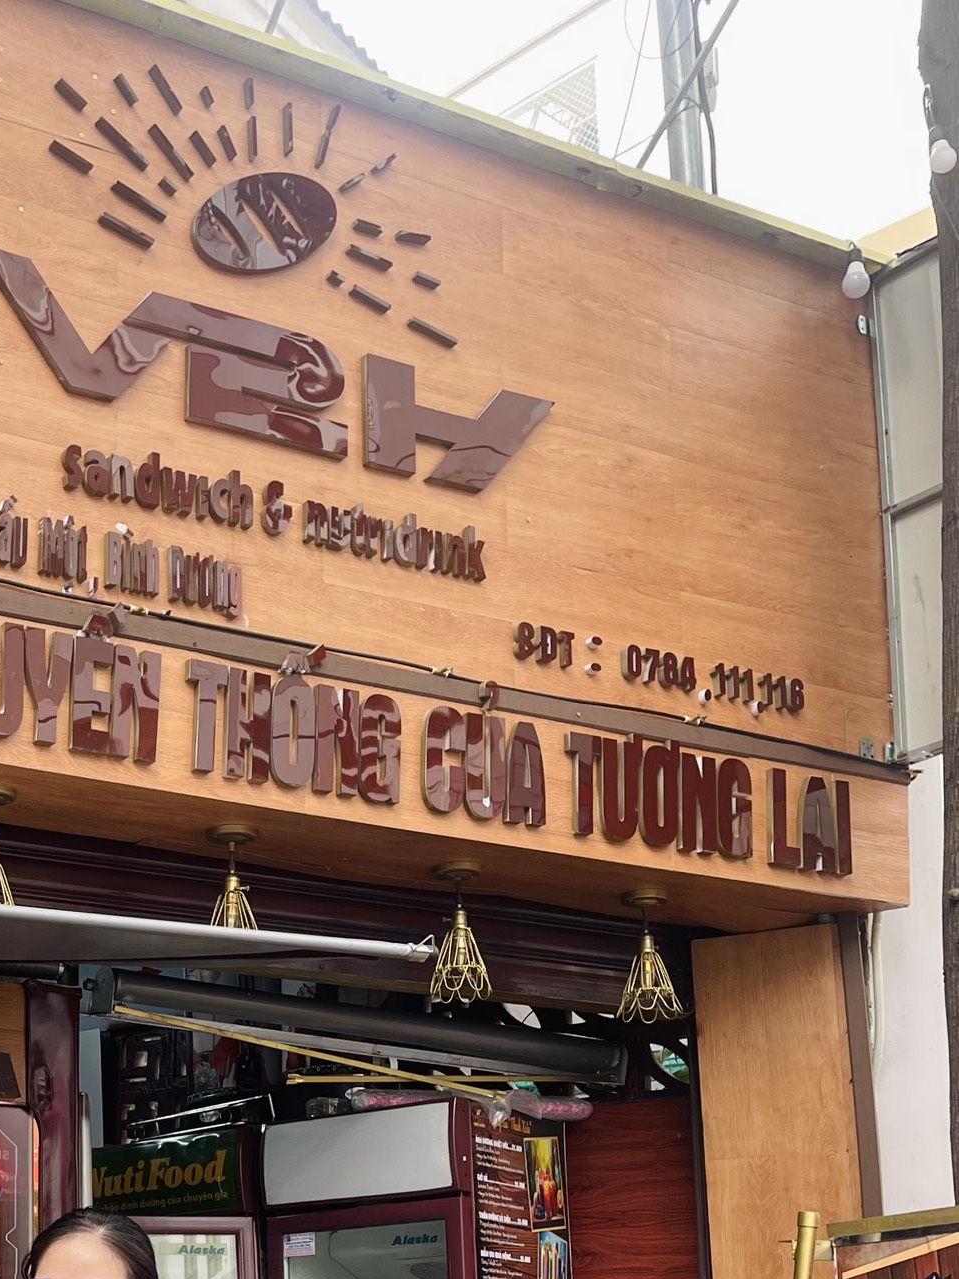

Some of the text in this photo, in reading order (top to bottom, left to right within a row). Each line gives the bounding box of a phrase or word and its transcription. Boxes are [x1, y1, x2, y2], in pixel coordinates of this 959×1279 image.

[62, 444, 255, 531] sandwich
[262, 480, 293, 537] &
[104, 522, 159, 598] Bình
[167, 544, 243, 620] Dương
[186, 642, 402, 806] THỐNG
[421, 680, 547, 828] CỦA
[564, 728, 754, 859] TƯƠNG
[766, 767, 852, 877] LAI
[178, 1244, 225, 1255] Alaska
[392, 1233, 439, 1246] Alaska
